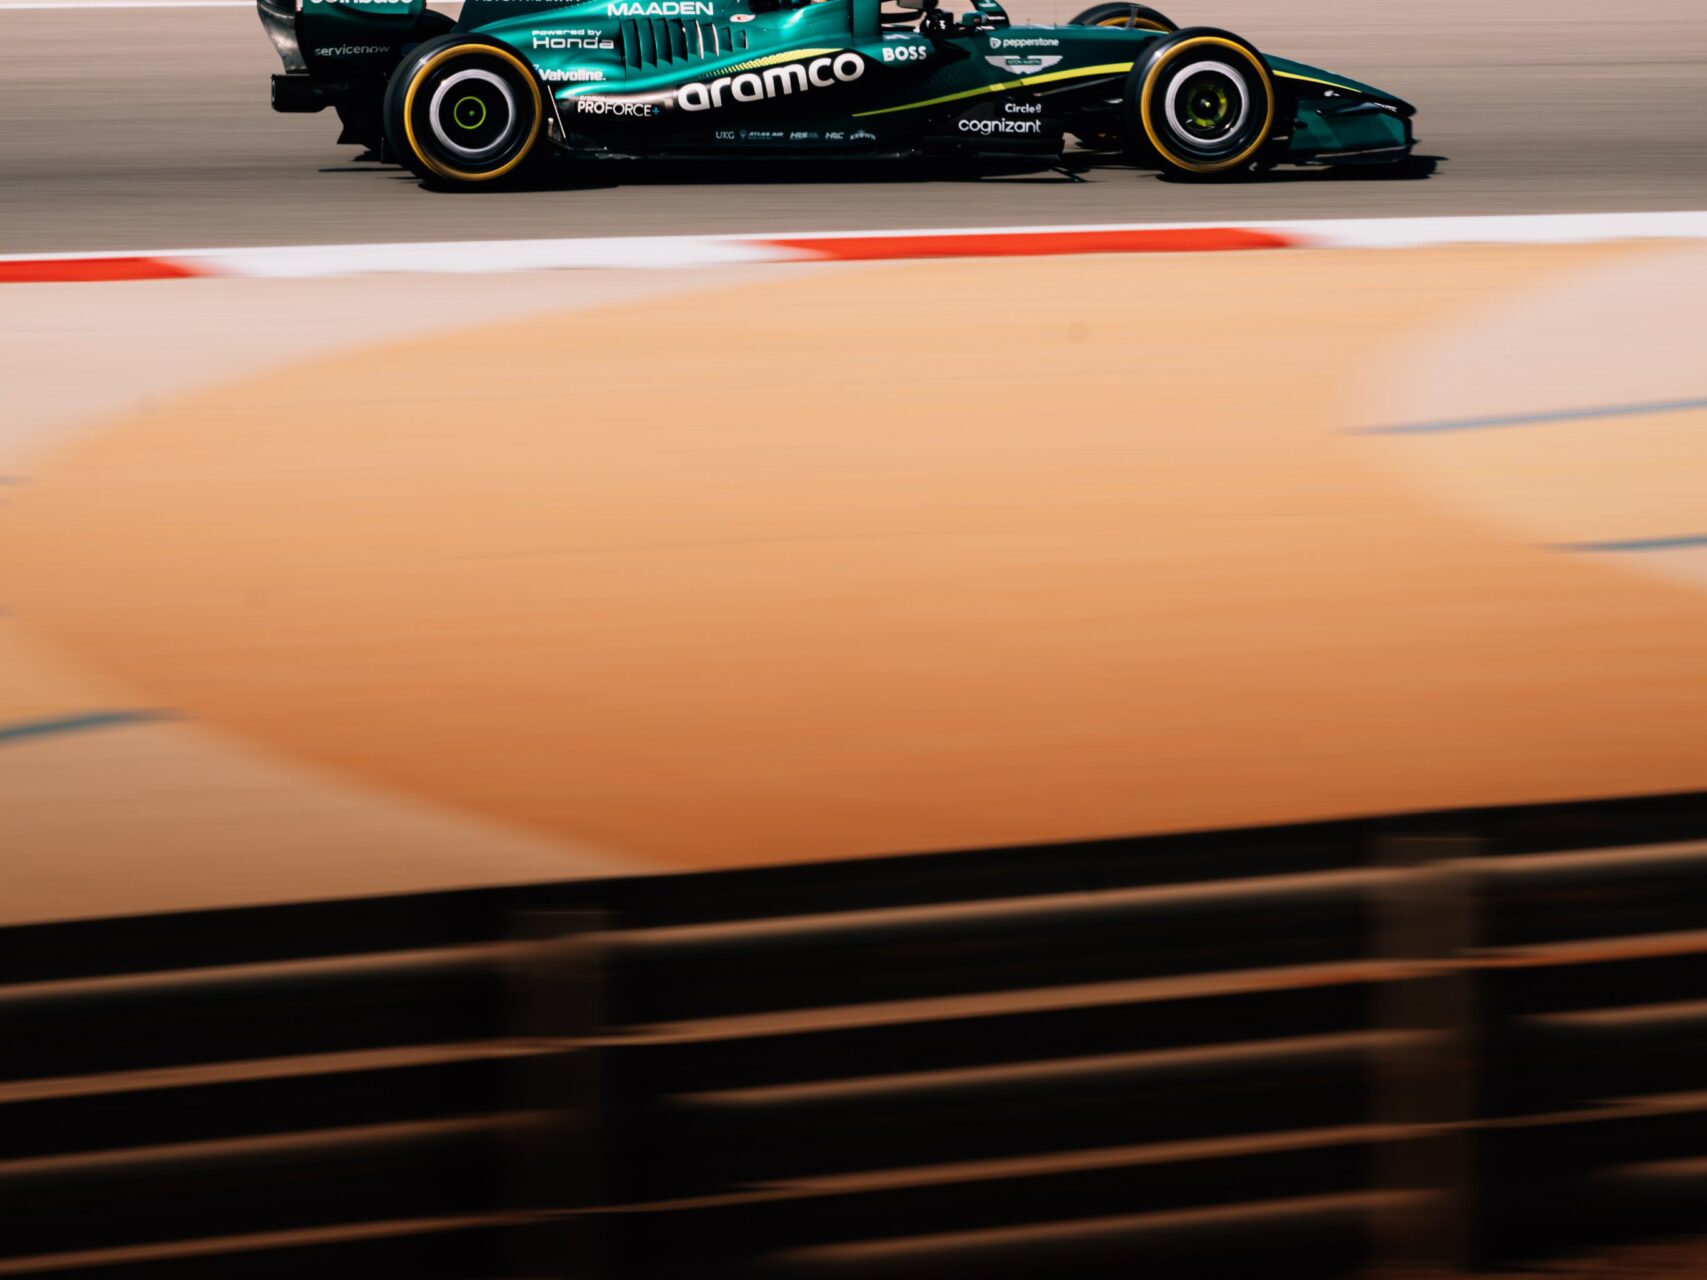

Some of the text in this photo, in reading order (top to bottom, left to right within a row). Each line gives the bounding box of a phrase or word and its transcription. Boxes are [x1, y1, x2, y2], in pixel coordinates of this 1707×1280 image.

[607, 1, 714, 17] MAADEN
[532, 36, 615, 49] Honda
[1003, 37, 1059, 47] pepperstone
[315, 44, 391, 57] servicenow
[882, 45, 927, 62] BOSS
[678, 52, 865, 112] aramco
[1005, 103, 1035, 113] Circle
[958, 119, 1041, 135] cognizant
